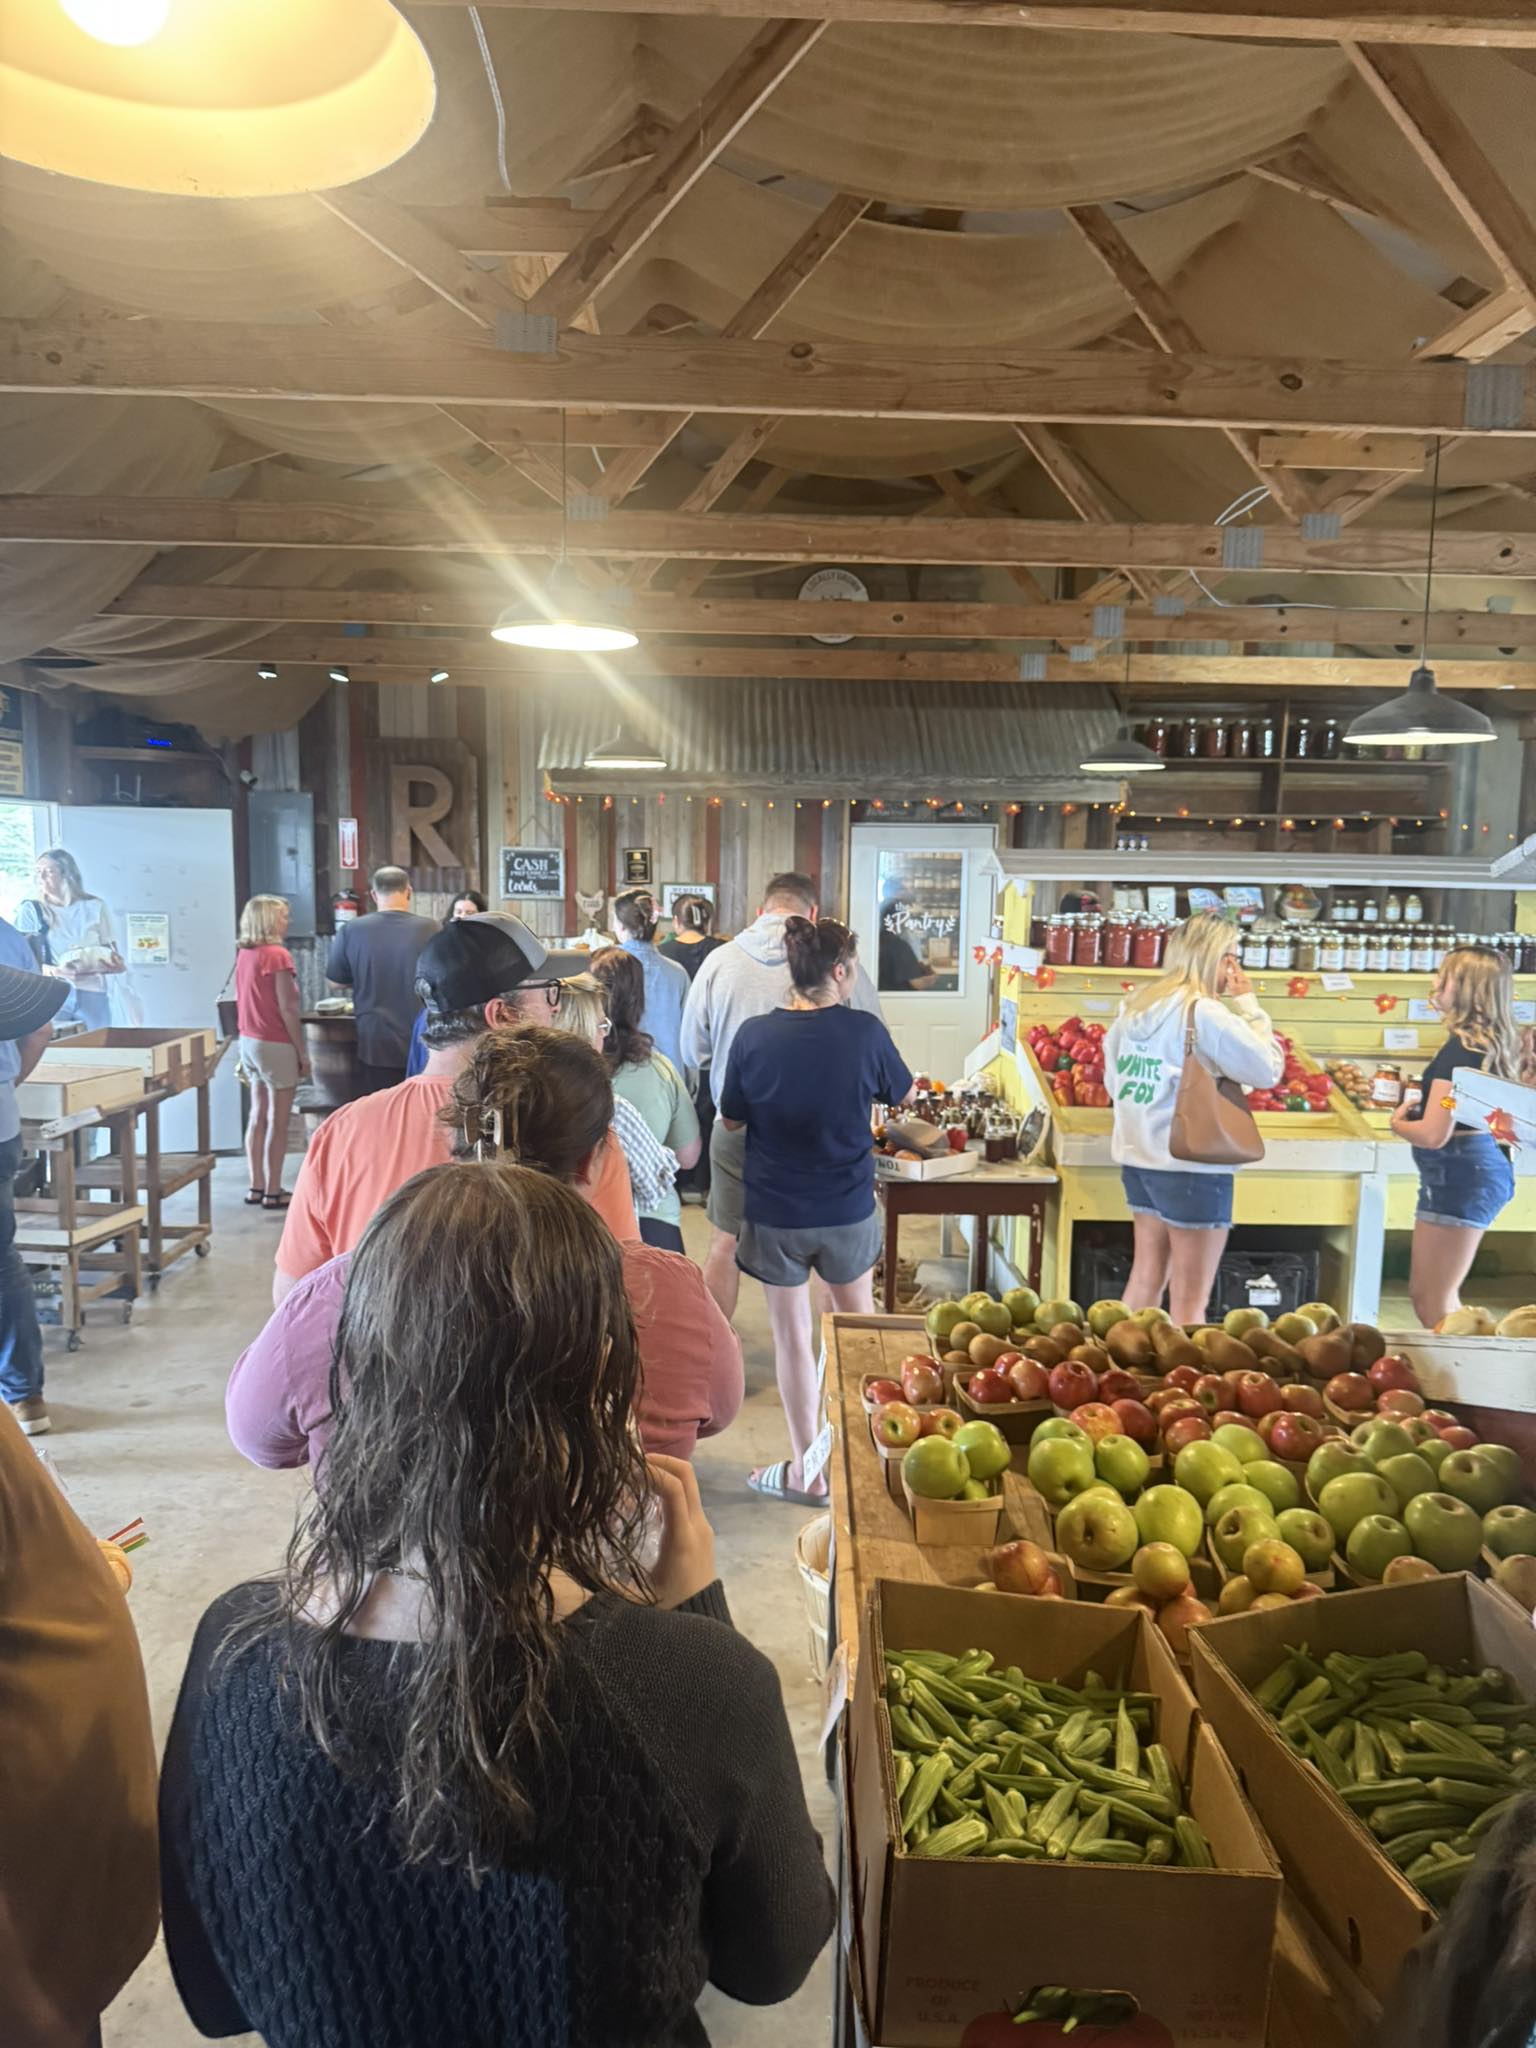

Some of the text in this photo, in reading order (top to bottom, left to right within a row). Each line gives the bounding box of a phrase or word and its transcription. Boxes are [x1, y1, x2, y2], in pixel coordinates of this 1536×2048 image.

[391, 764, 461, 867] R
[513, 858, 549, 871] CASH
[892, 911, 945, 938] Pantry
[1117, 1054, 1163, 1081] WHITE
[1118, 1081, 1155, 1104] FOX
[906, 1976, 980, 1993] PRODUCE
[930, 1995, 951, 2008] OF
